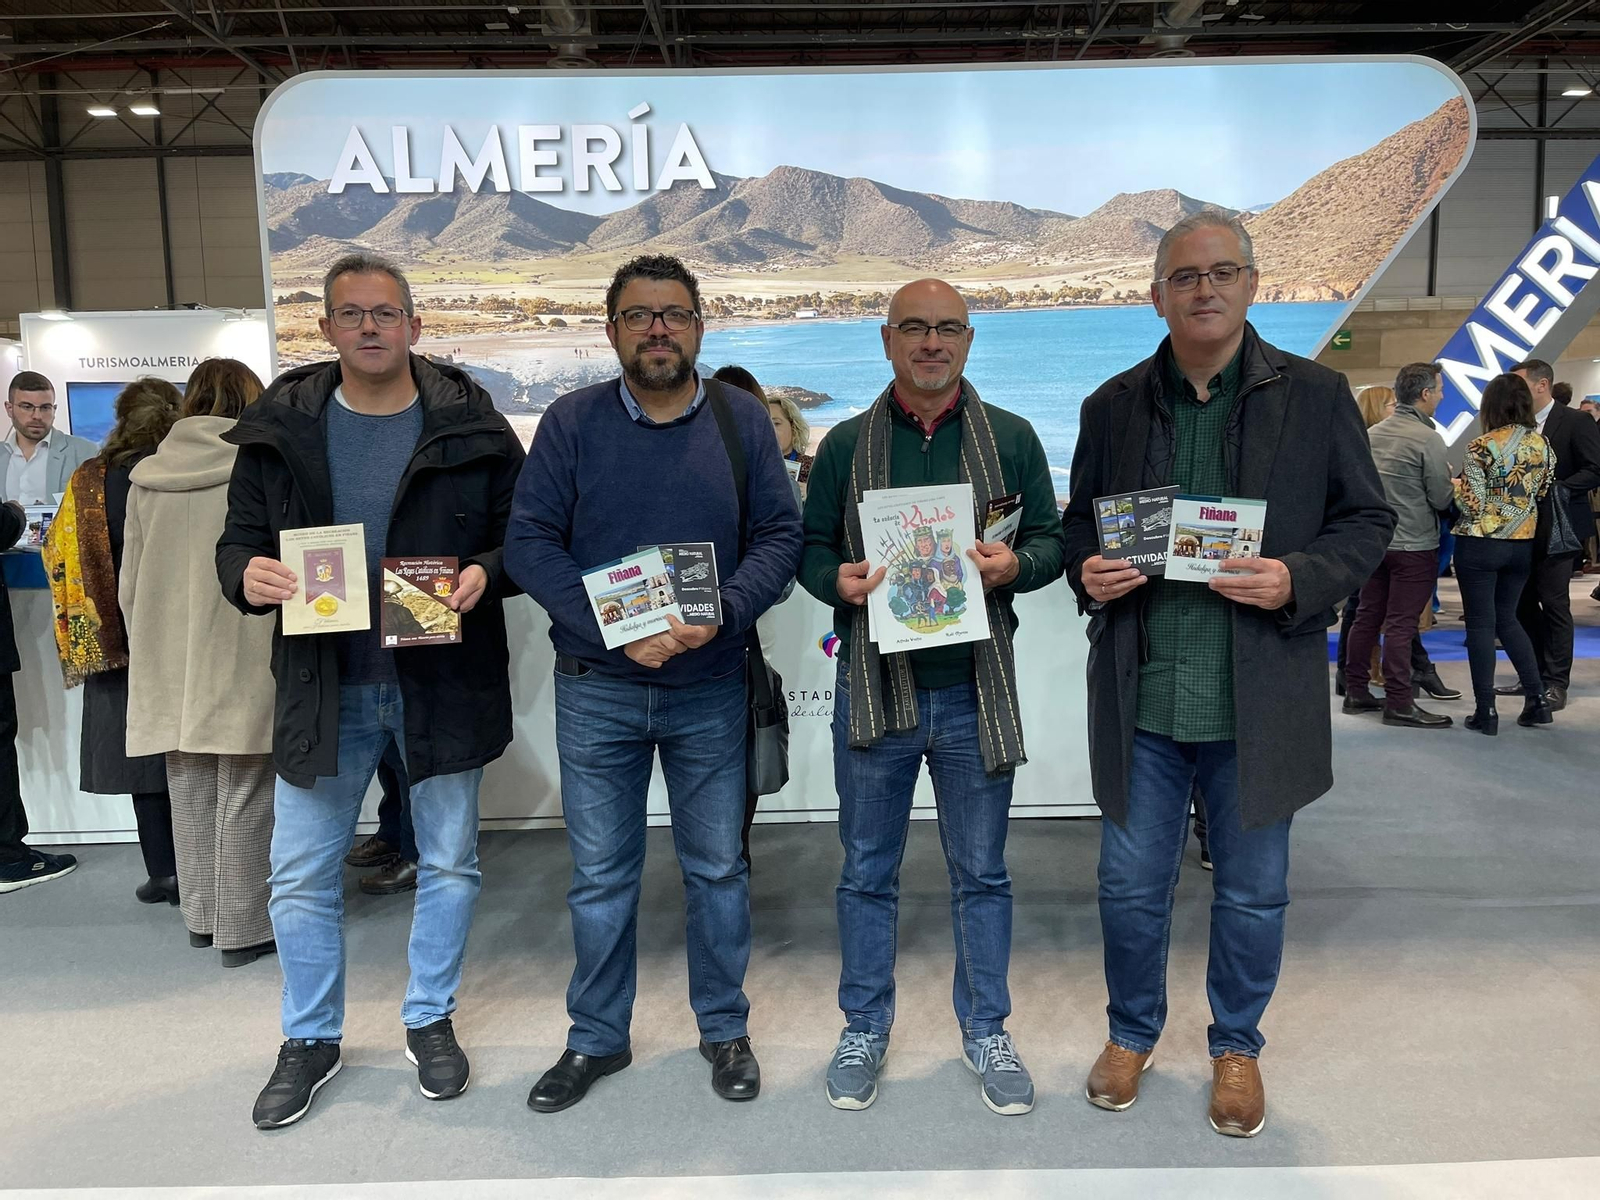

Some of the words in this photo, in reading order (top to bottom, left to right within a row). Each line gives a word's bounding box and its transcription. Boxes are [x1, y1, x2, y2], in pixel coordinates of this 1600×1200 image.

[327, 101, 717, 194] ALMERÍA
[79, 356, 234, 369] TURISMOALMERIA
[1199, 505, 1238, 523] Fiñana
[607, 564, 643, 585] Fiñana
